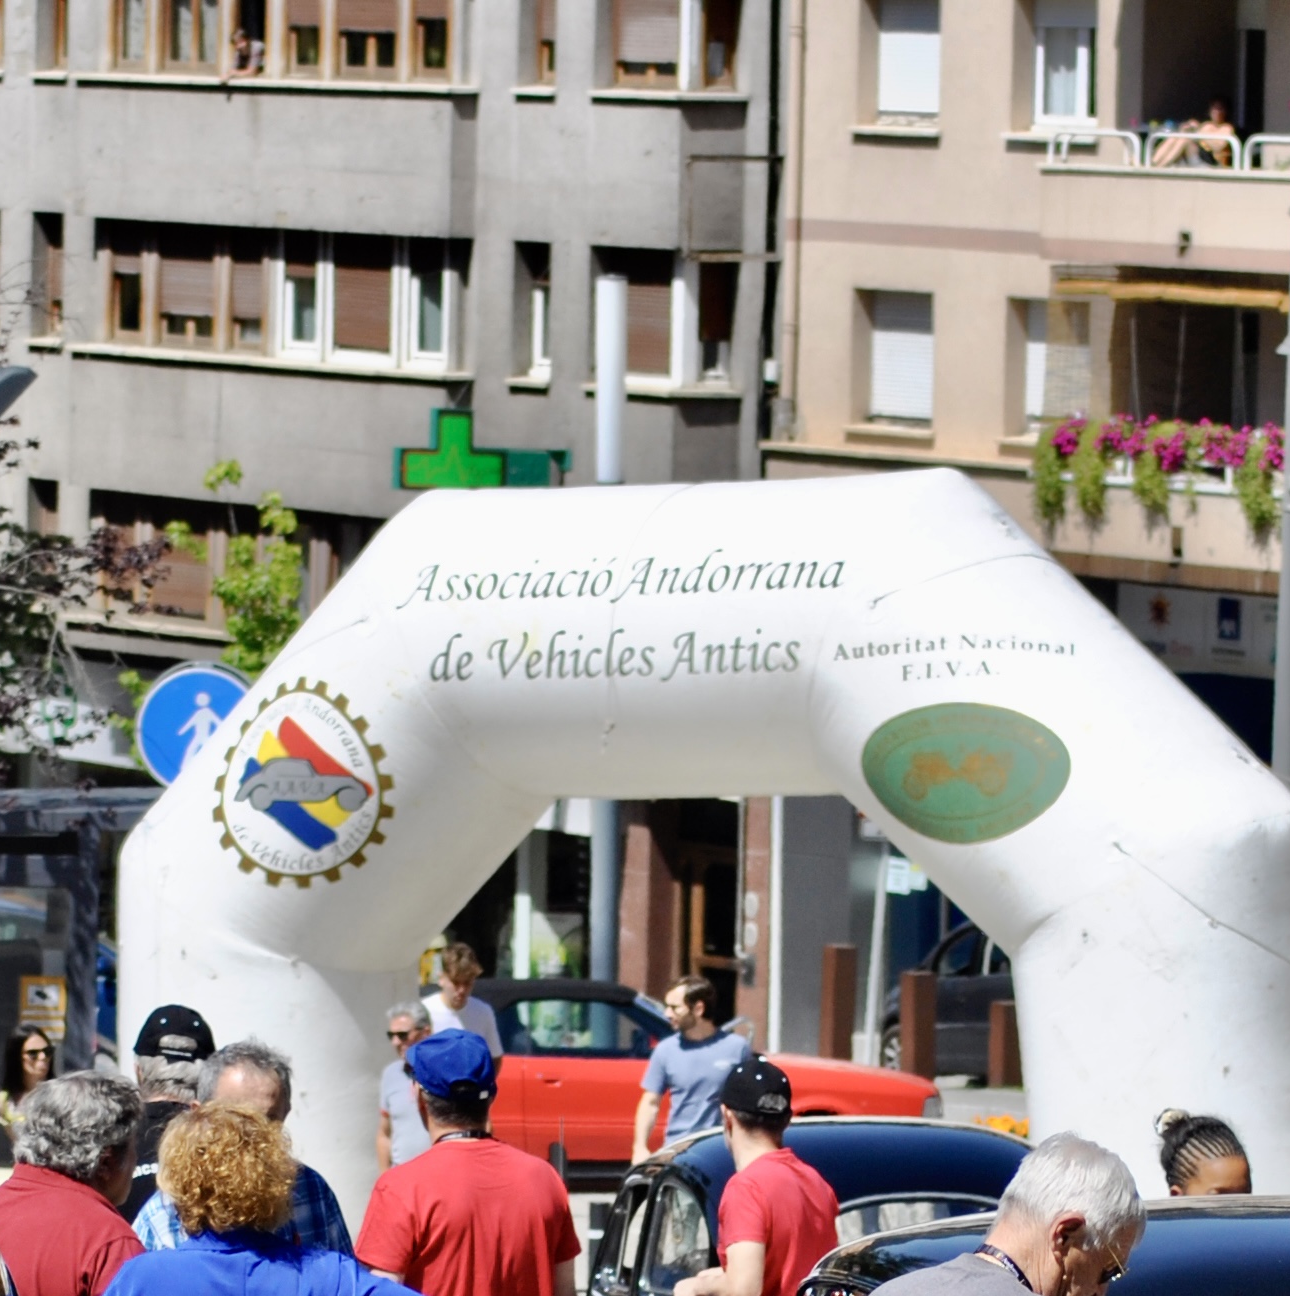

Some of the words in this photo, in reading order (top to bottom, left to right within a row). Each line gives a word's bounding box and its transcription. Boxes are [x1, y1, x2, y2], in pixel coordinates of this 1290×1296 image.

[396, 557, 618, 609] Associació
[609, 549, 846, 604] Andorrana
[429, 632, 474, 682] de
[487, 627, 656, 681] Vehicles
[660, 628, 801, 682] Antics
[833, 636, 948, 661] Autoritat
[959, 634, 1076, 656] Nacional
[901, 660, 1000, 682] F.I.V.A.
[251, 837, 325, 872] Vehicles
